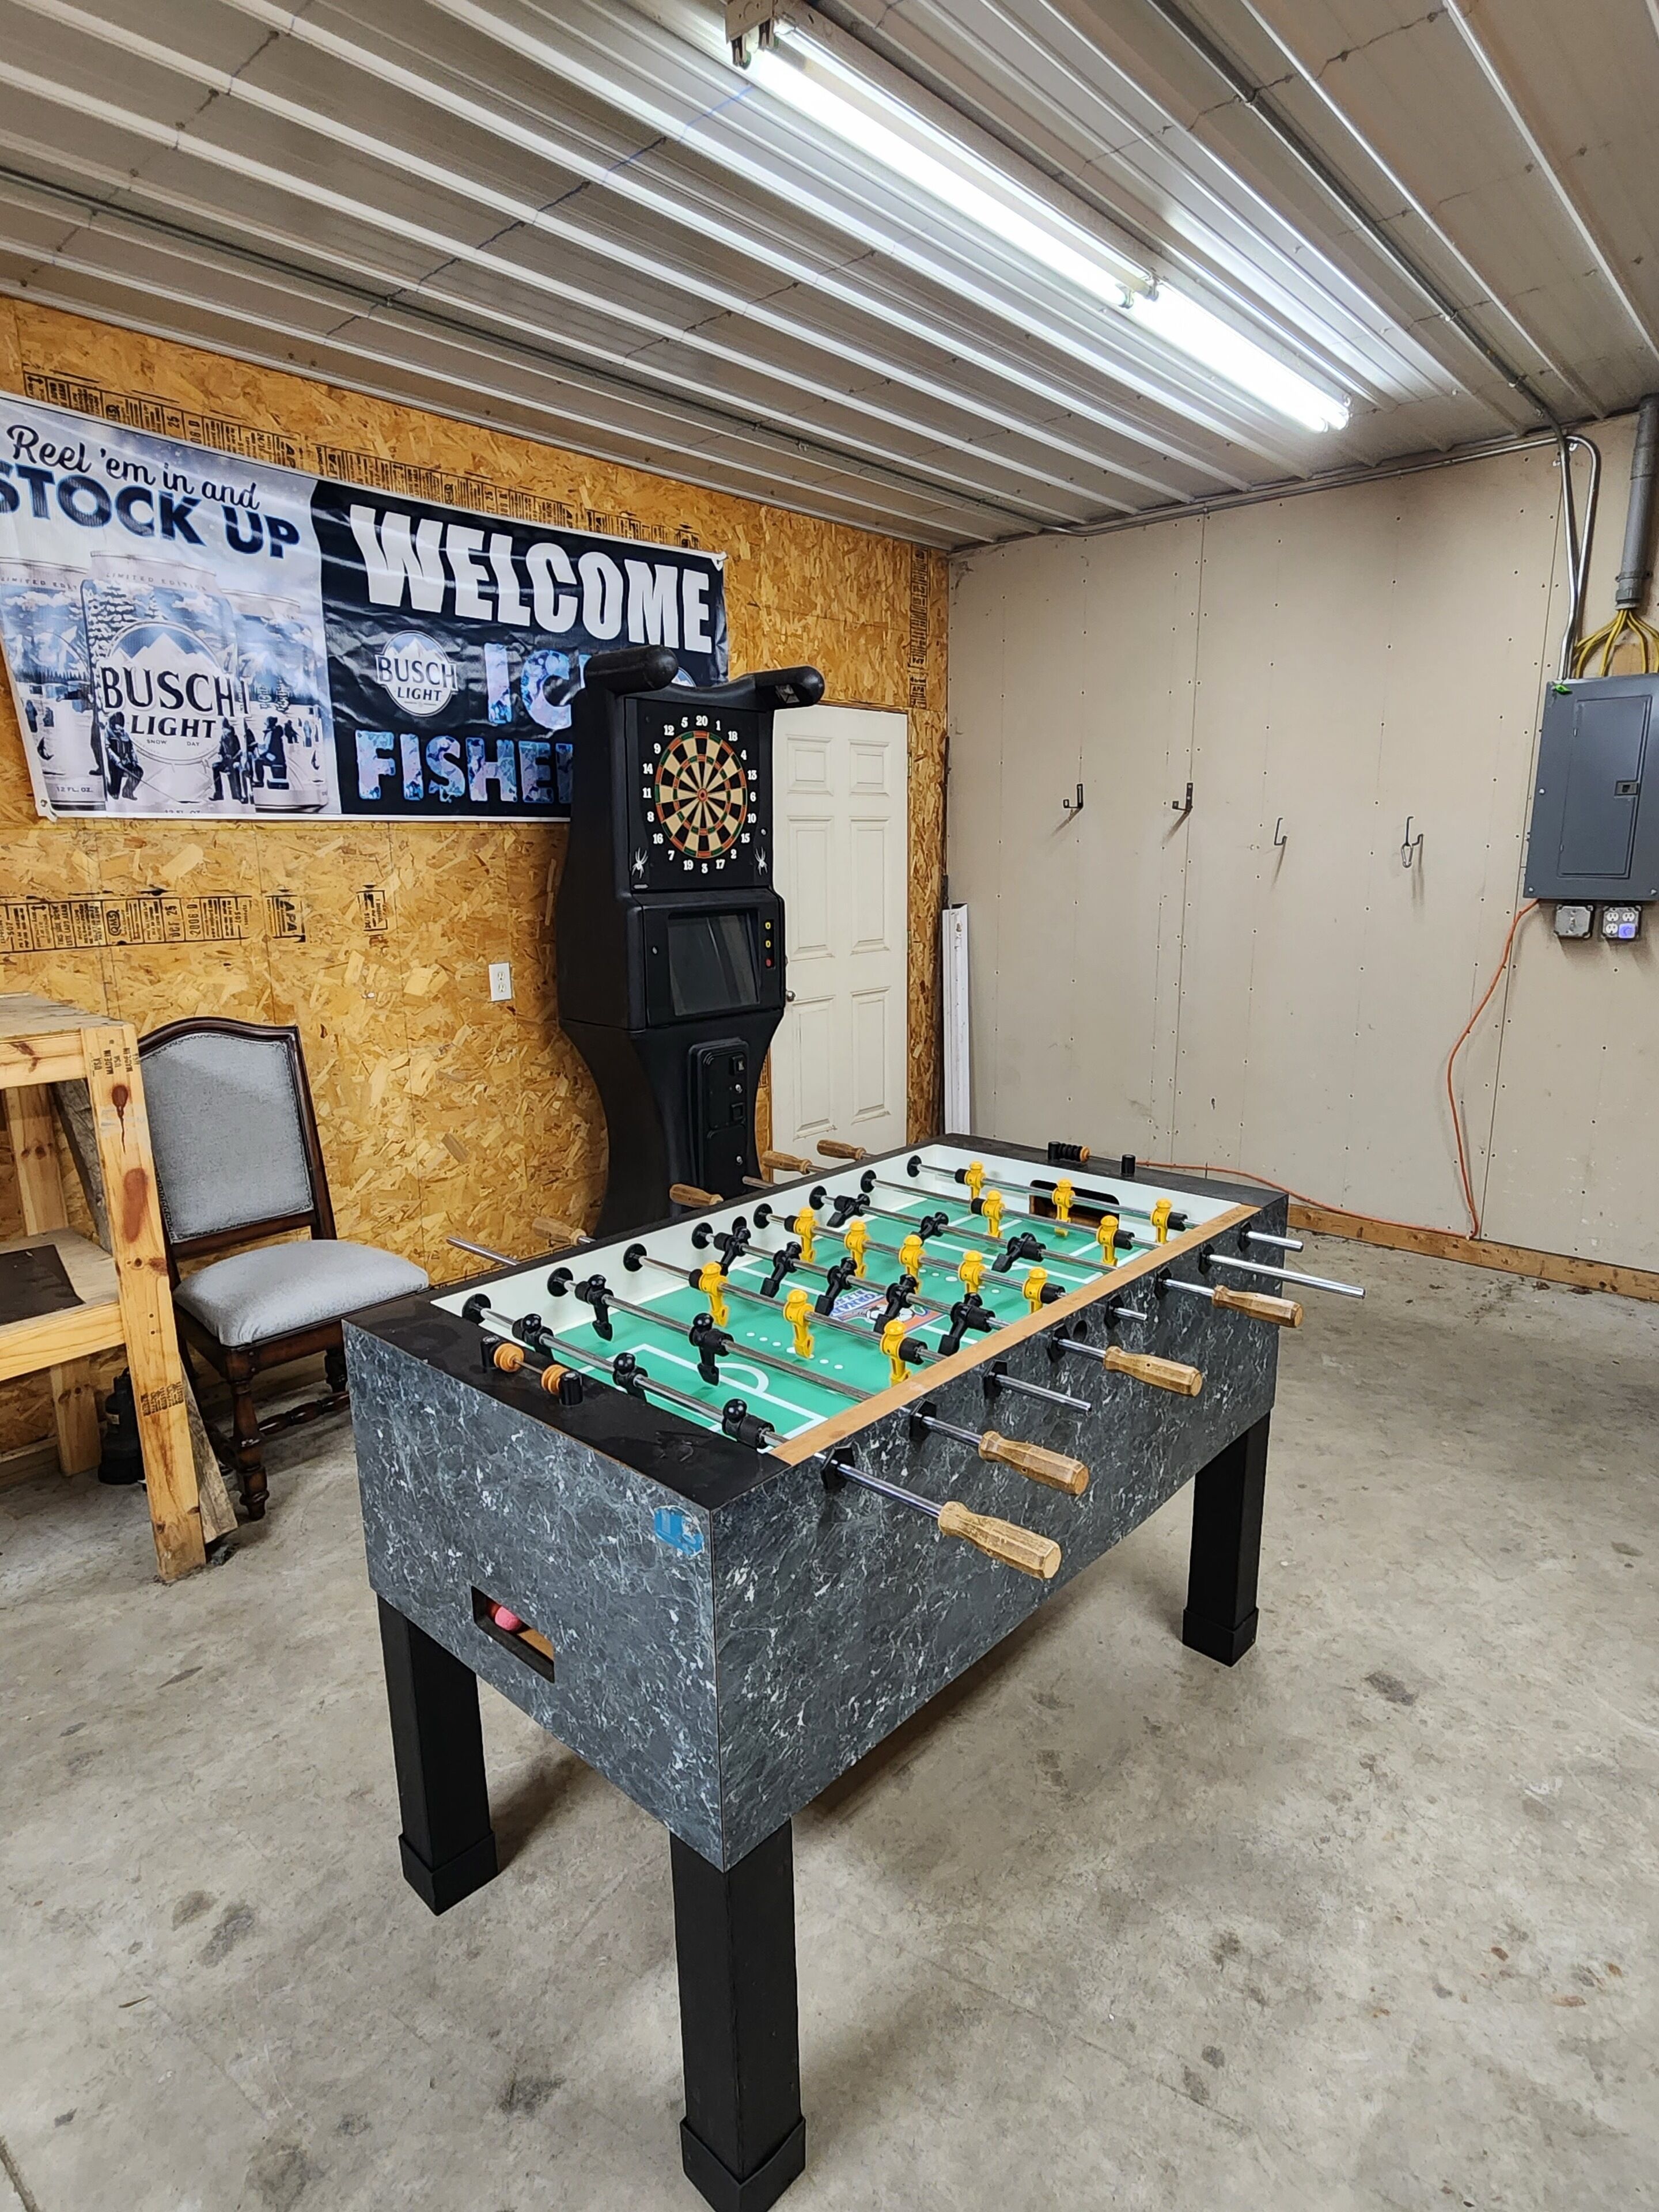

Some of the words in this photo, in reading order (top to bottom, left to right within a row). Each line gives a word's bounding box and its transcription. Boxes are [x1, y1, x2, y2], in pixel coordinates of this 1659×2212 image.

[6, 425, 92, 473] Reel
[100, 448, 156, 486] 'em
[163, 462, 194, 495] in
[202, 482, 261, 510] and
[223, 506, 301, 559] UP
[106, 573, 154, 582] LIMITED
[350, 504, 713, 653] WELCOME
[377, 654, 457, 690] BUSCH
[99, 666, 235, 717] BUSCH
[397, 686, 442, 702] LIGHT
[130, 714, 217, 738] LIGHT
[681, 717, 688, 728] 5
[695, 715, 708, 726] 20
[715, 720, 721, 731] 1
[663, 724, 675, 736] 12
[728, 730, 738, 741] 18
[653, 743, 661, 753] 9
[740, 749, 747, 760] 4
[642, 763, 653, 774] 14
[747, 770, 757, 780] 13
[642, 787, 652, 798] 11
[749, 791, 756, 802] 6
[647, 811, 654, 822] 8
[747, 813, 757, 824] 10
[653, 833, 664, 844] 16
[741, 833, 750, 843] 15
[668, 850, 675, 861] 7
[730, 849, 737, 859] 2
[683, 859, 694, 870] 19
[701, 863, 709, 874] 3
[715, 859, 725, 869] 17
[165, 906, 177, 916] 25
[283, 901, 297, 931] APA
[6, 922, 14, 936] 507
[108, 914, 118, 933] QMS
[188, 914, 200, 935] 2006
[93, 1057, 103, 1070] USA
[104, 1057, 114, 1075] MADE
[113, 1055, 122, 1068] USA
[123, 1054, 134, 1073] MADE
